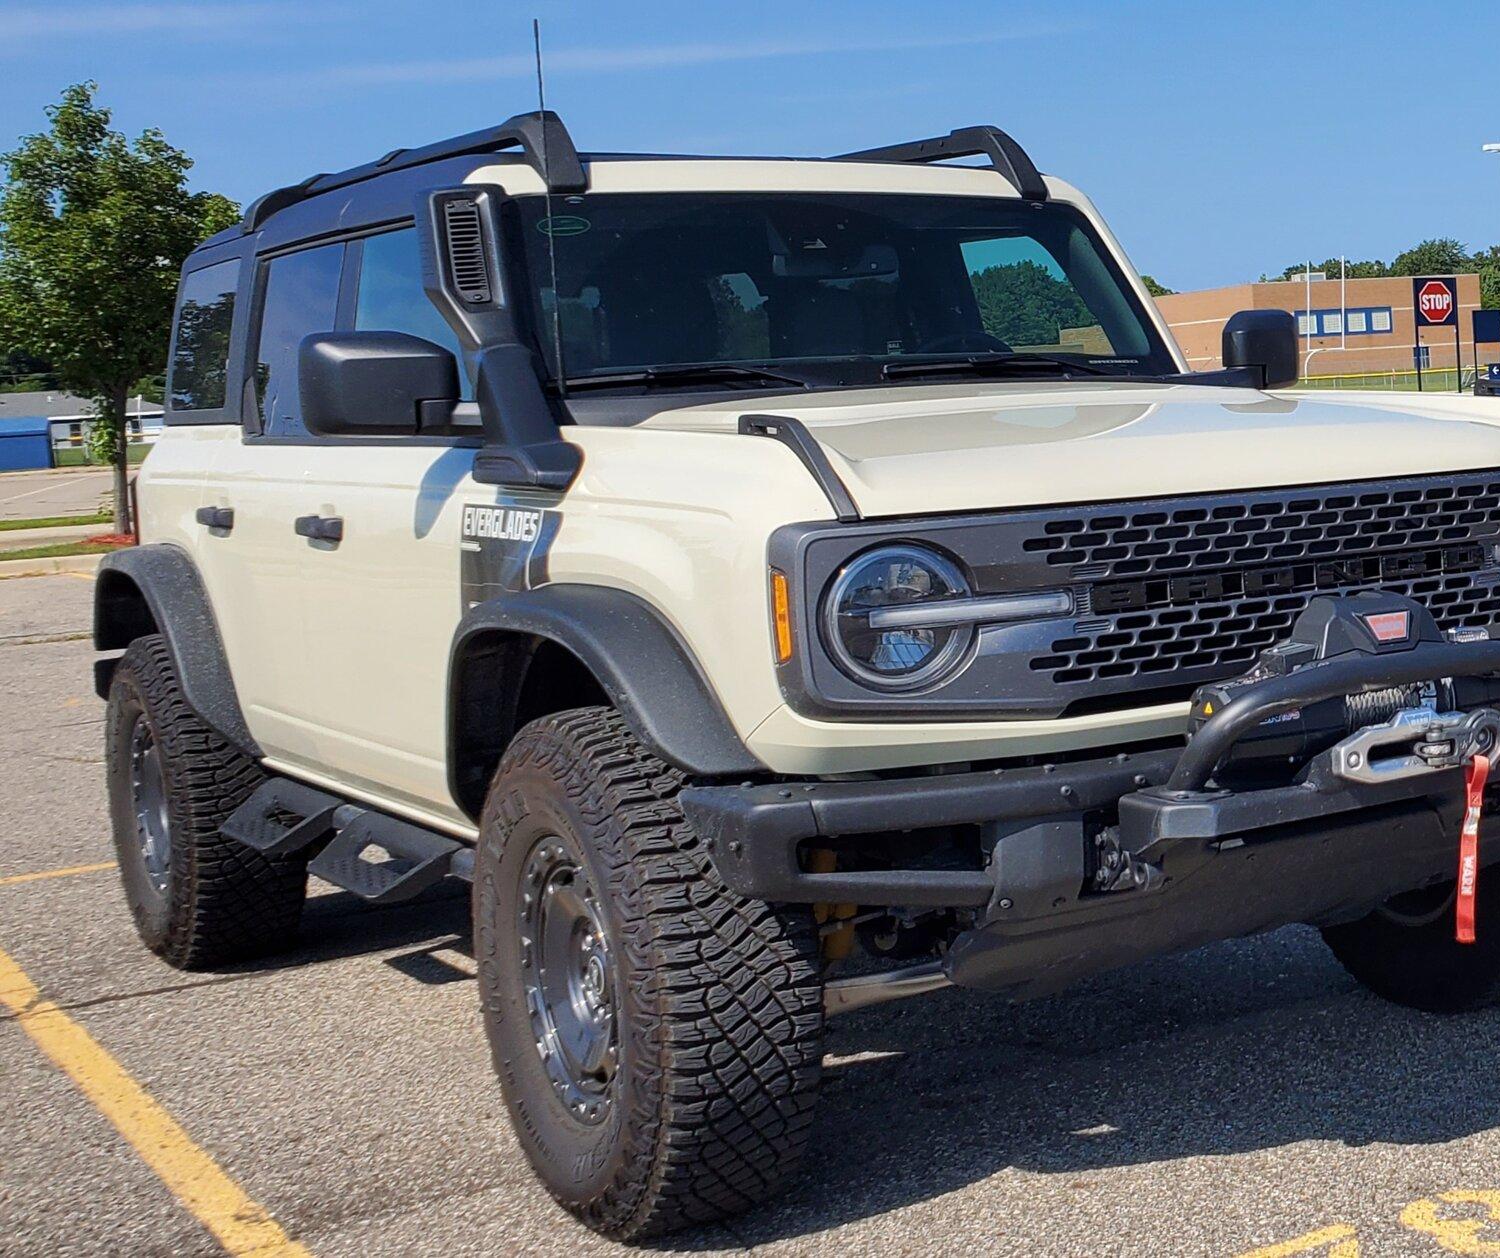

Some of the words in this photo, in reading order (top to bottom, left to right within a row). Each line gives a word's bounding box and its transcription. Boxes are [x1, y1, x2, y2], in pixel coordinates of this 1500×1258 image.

[1422, 294, 1450, 310] STOP
[464, 507, 540, 542] EVERGLADES
[1093, 545, 1485, 612] BRONCO
[1461, 855, 1475, 896] WARN
